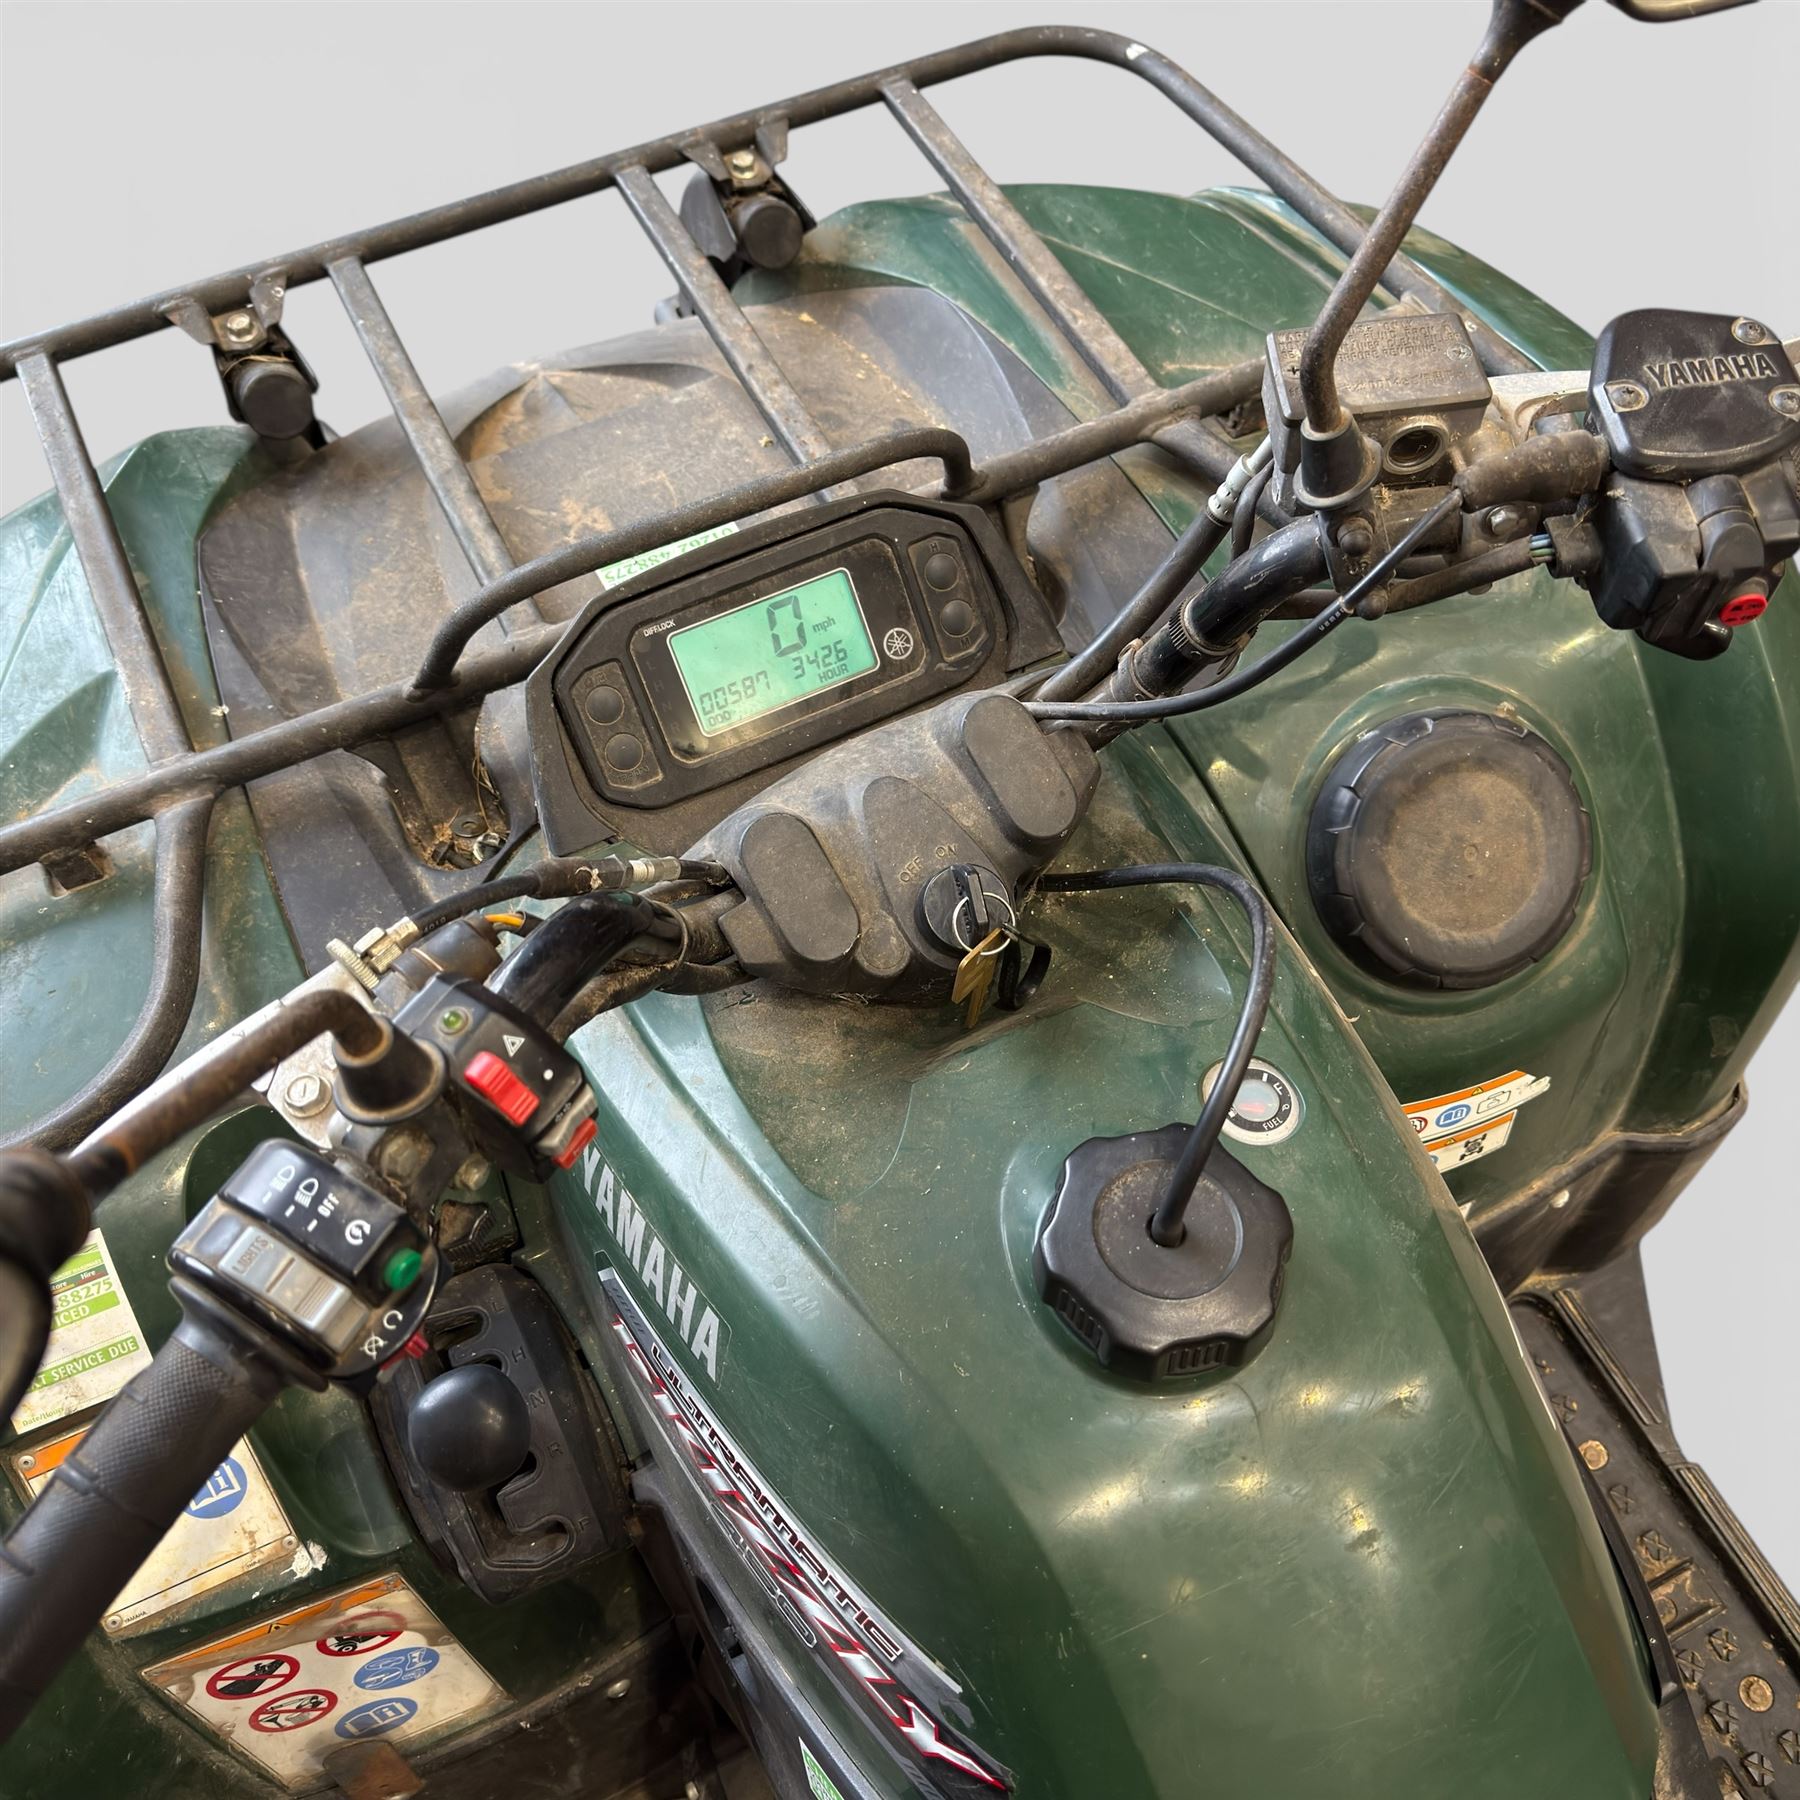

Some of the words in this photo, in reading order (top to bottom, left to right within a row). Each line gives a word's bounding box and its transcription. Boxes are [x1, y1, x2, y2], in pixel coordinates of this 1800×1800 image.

[1644, 353, 1779, 390] YAMAHA
[767, 595, 807, 657] 0
[812, 616, 837, 633] mph
[818, 663, 849, 682] HOUR
[699, 670, 770, 716] 00587
[898, 855, 923, 883] OFF
[935, 843, 959, 859] ON
[1273, 1082, 1283, 1096] F
[1262, 1116, 1284, 1131] FUEL
[317, 1192, 340, 1218] OFF
[231, 1235, 270, 1275] LIGHTS
[583, 1144, 719, 1383] YAMAHA
[80, 1270, 96, 1280] Hire
[54, 1277, 113, 1309] 88275
[492, 1301, 505, 1313] L
[52, 1351, 106, 1381] SERVICE
[109, 1340, 137, 1358] DUE
[511, 1346, 527, 1363] H
[529, 1390, 546, 1409] N
[651, 1342, 903, 1663] ULTRAMATIC
